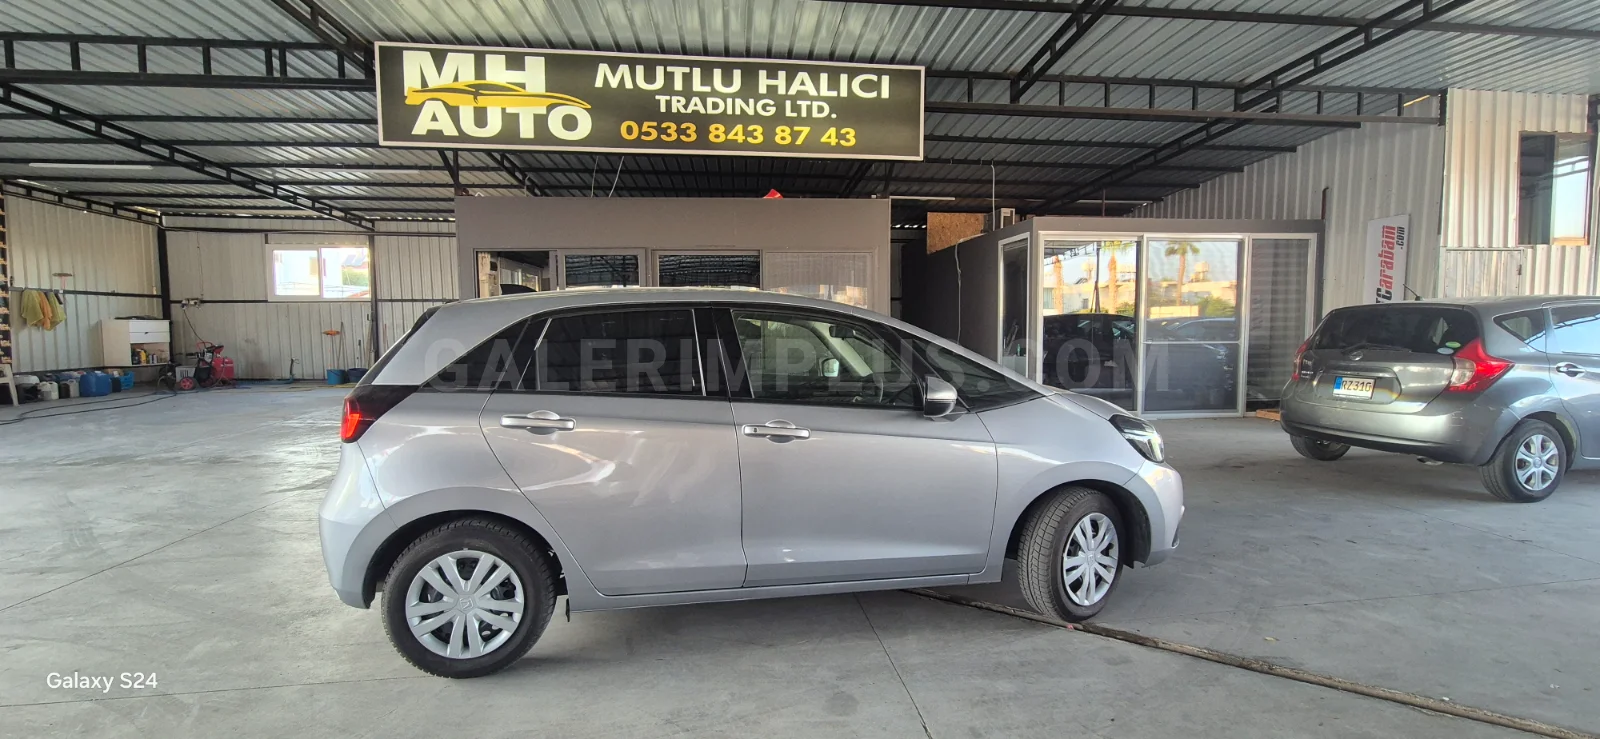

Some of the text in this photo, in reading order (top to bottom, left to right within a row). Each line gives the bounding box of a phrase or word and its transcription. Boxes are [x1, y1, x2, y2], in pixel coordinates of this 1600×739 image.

[402, 50, 546, 97] MH
[594, 62, 890, 99] MUTLU HALICI
[411, 100, 593, 141] AUTO
[655, 95, 837, 119] TRADING LTD.
[620, 120, 857, 147] 0533 843 87 43
[1396, 226, 1406, 250] .com
